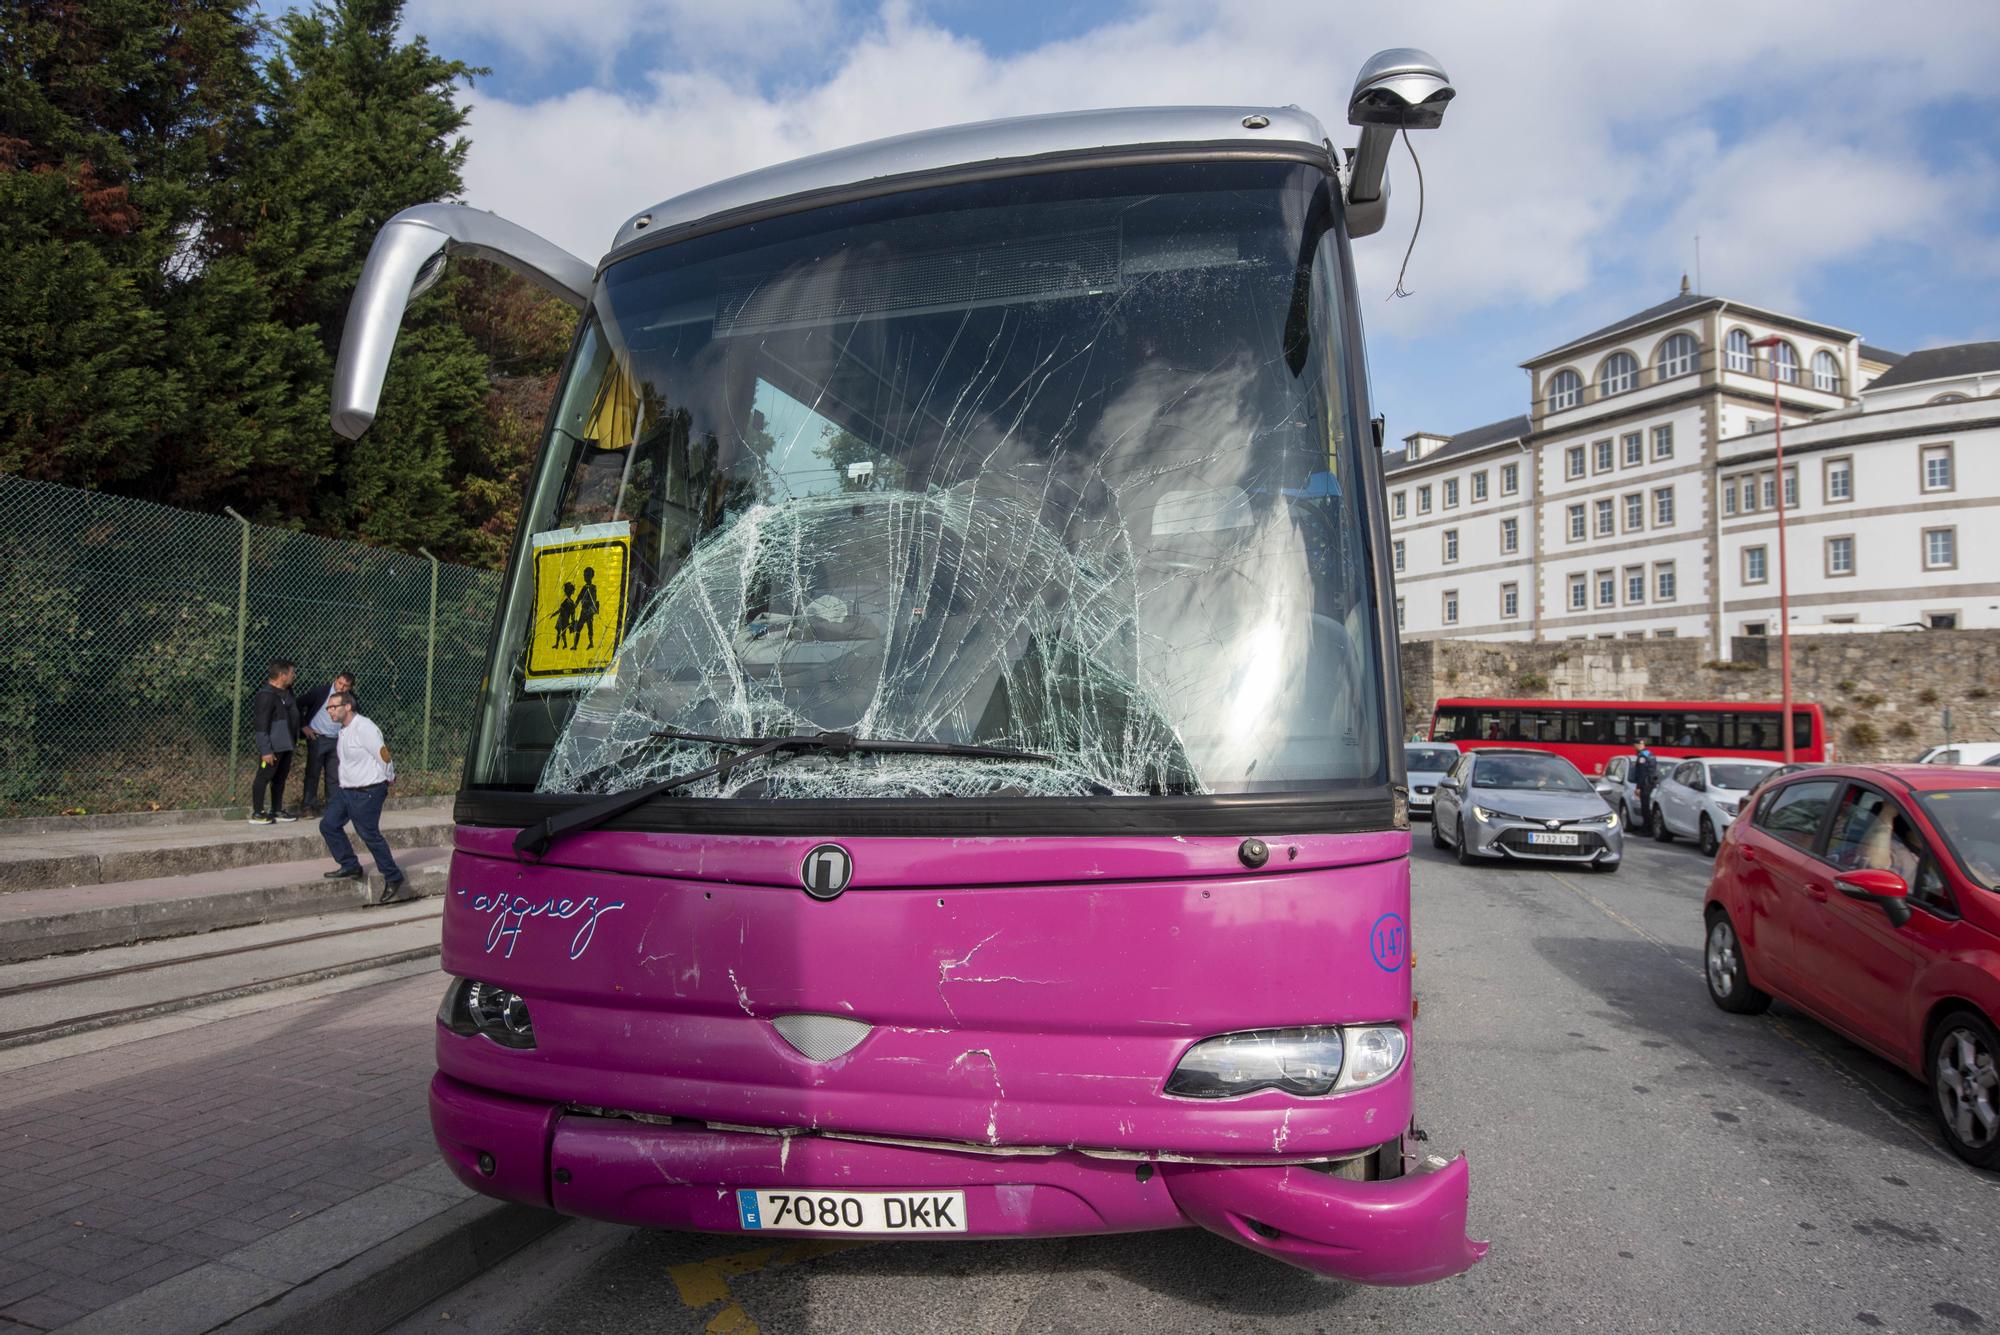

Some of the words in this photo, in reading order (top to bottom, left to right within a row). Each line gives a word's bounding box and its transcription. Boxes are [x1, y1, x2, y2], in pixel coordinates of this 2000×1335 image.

[1535, 834, 1557, 844] 7132
[1379, 927, 1403, 958] 147
[747, 1213, 756, 1223] E
[769, 1195, 864, 1228] 7080
[883, 1196, 957, 1229] DKK
